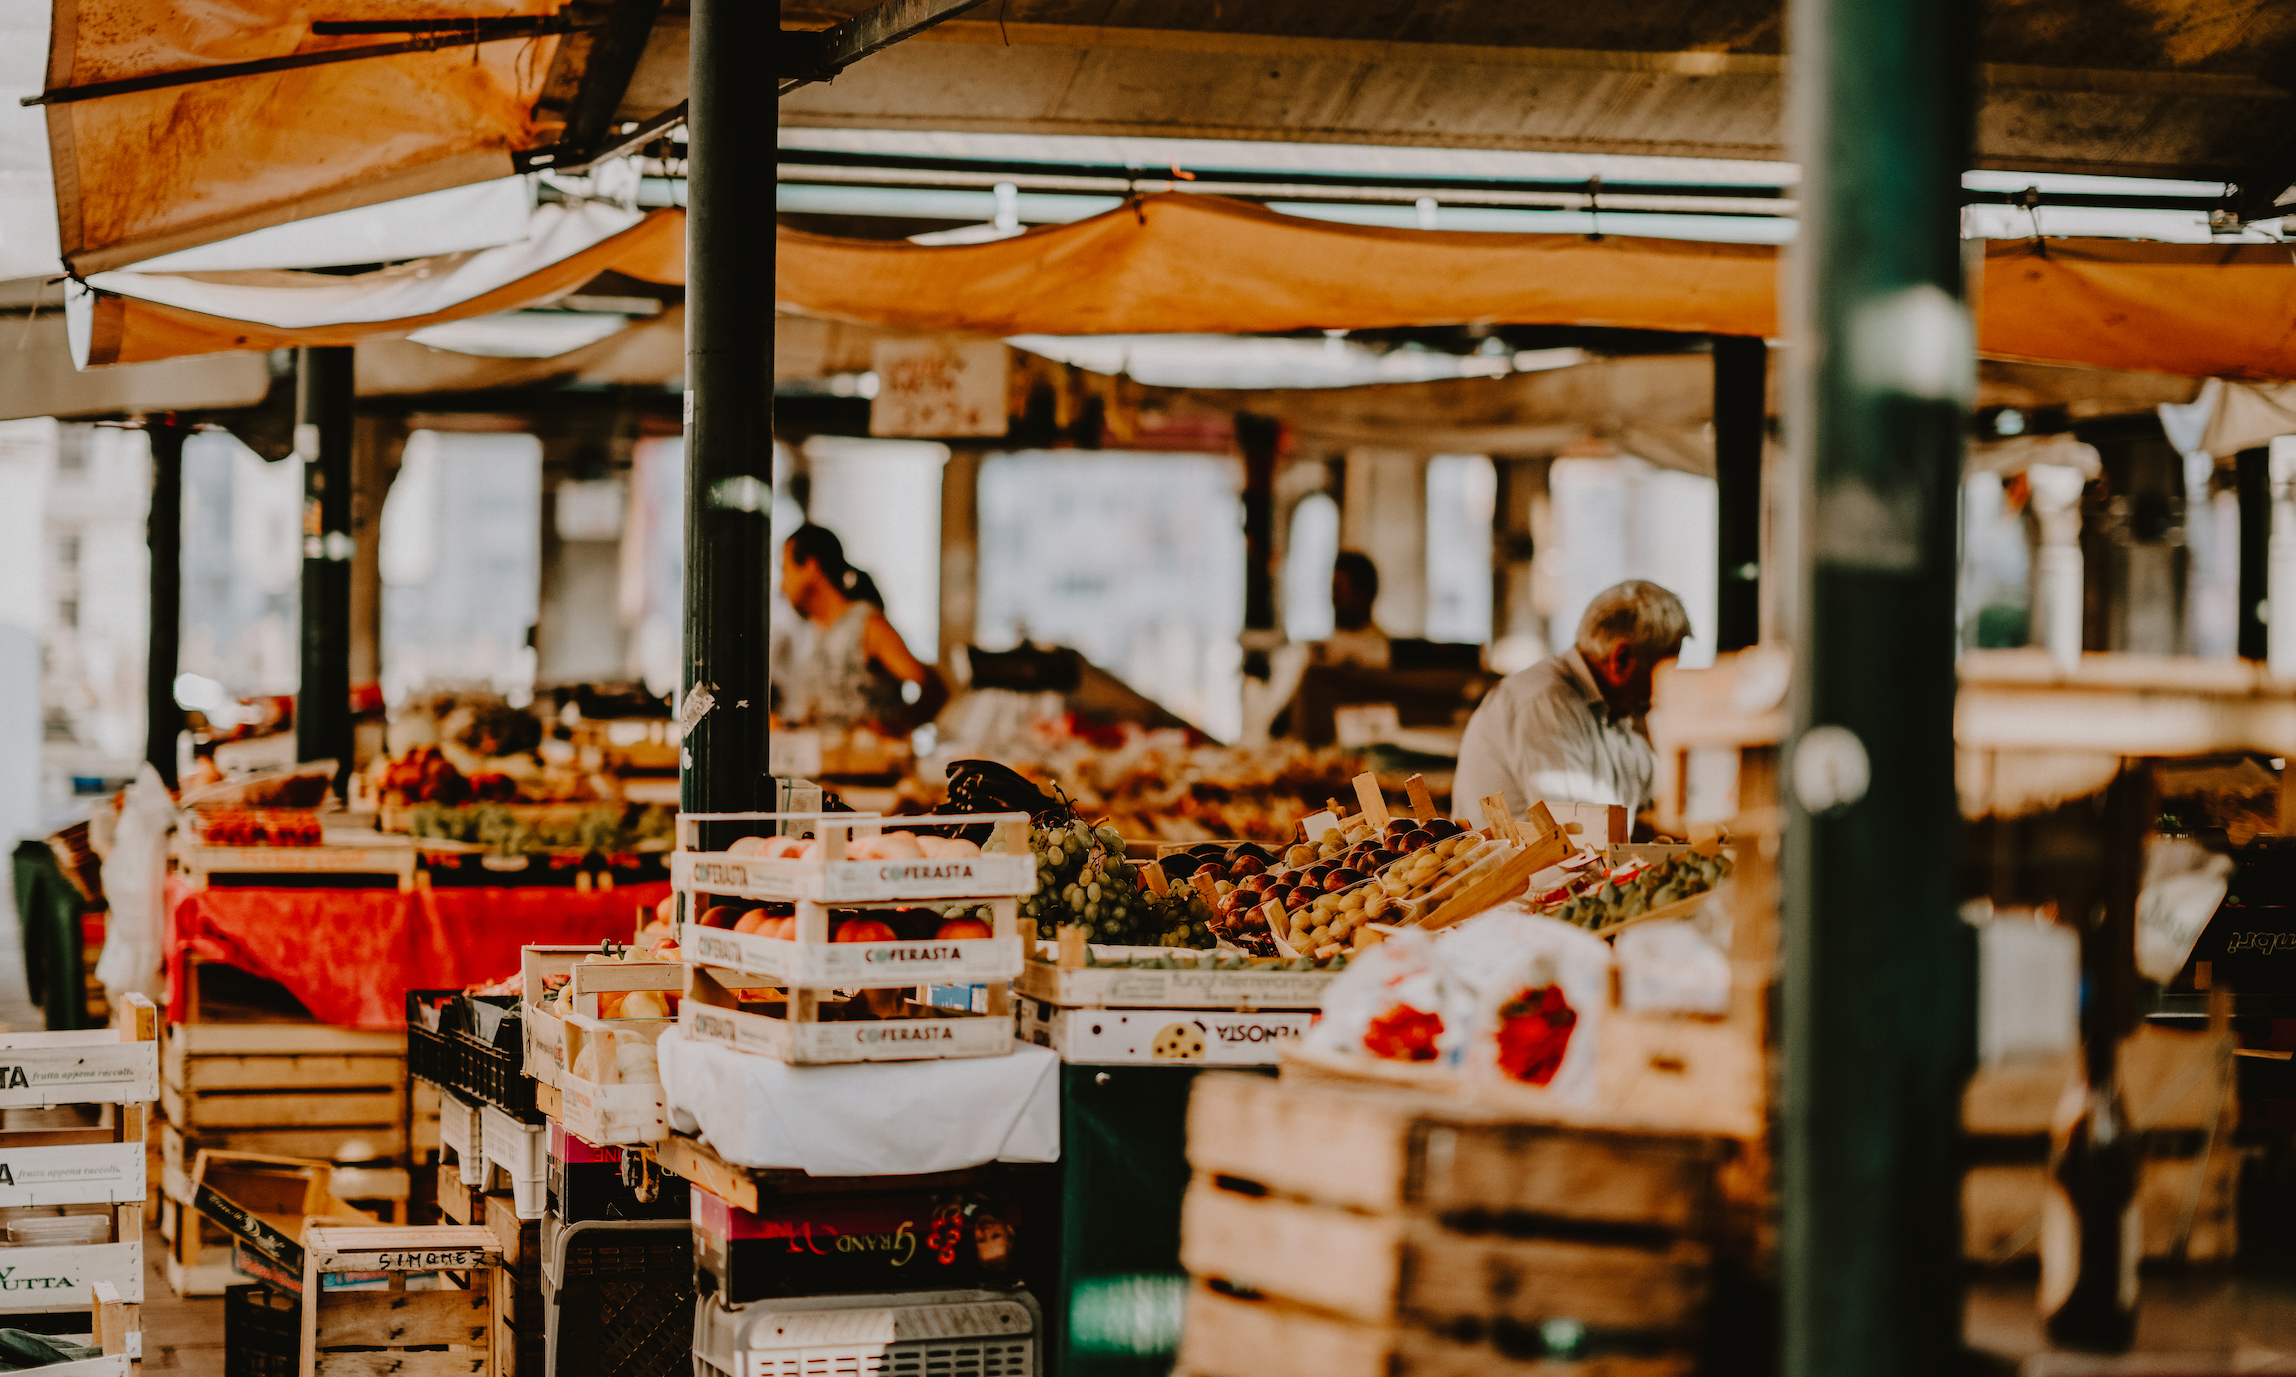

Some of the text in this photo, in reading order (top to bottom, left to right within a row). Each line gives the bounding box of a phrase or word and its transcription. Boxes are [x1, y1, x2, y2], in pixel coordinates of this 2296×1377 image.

[880, 864, 974, 882] COFERASTA
[865, 946, 961, 964] COFERASTA
[856, 1026, 953, 1044] COFERASTA
